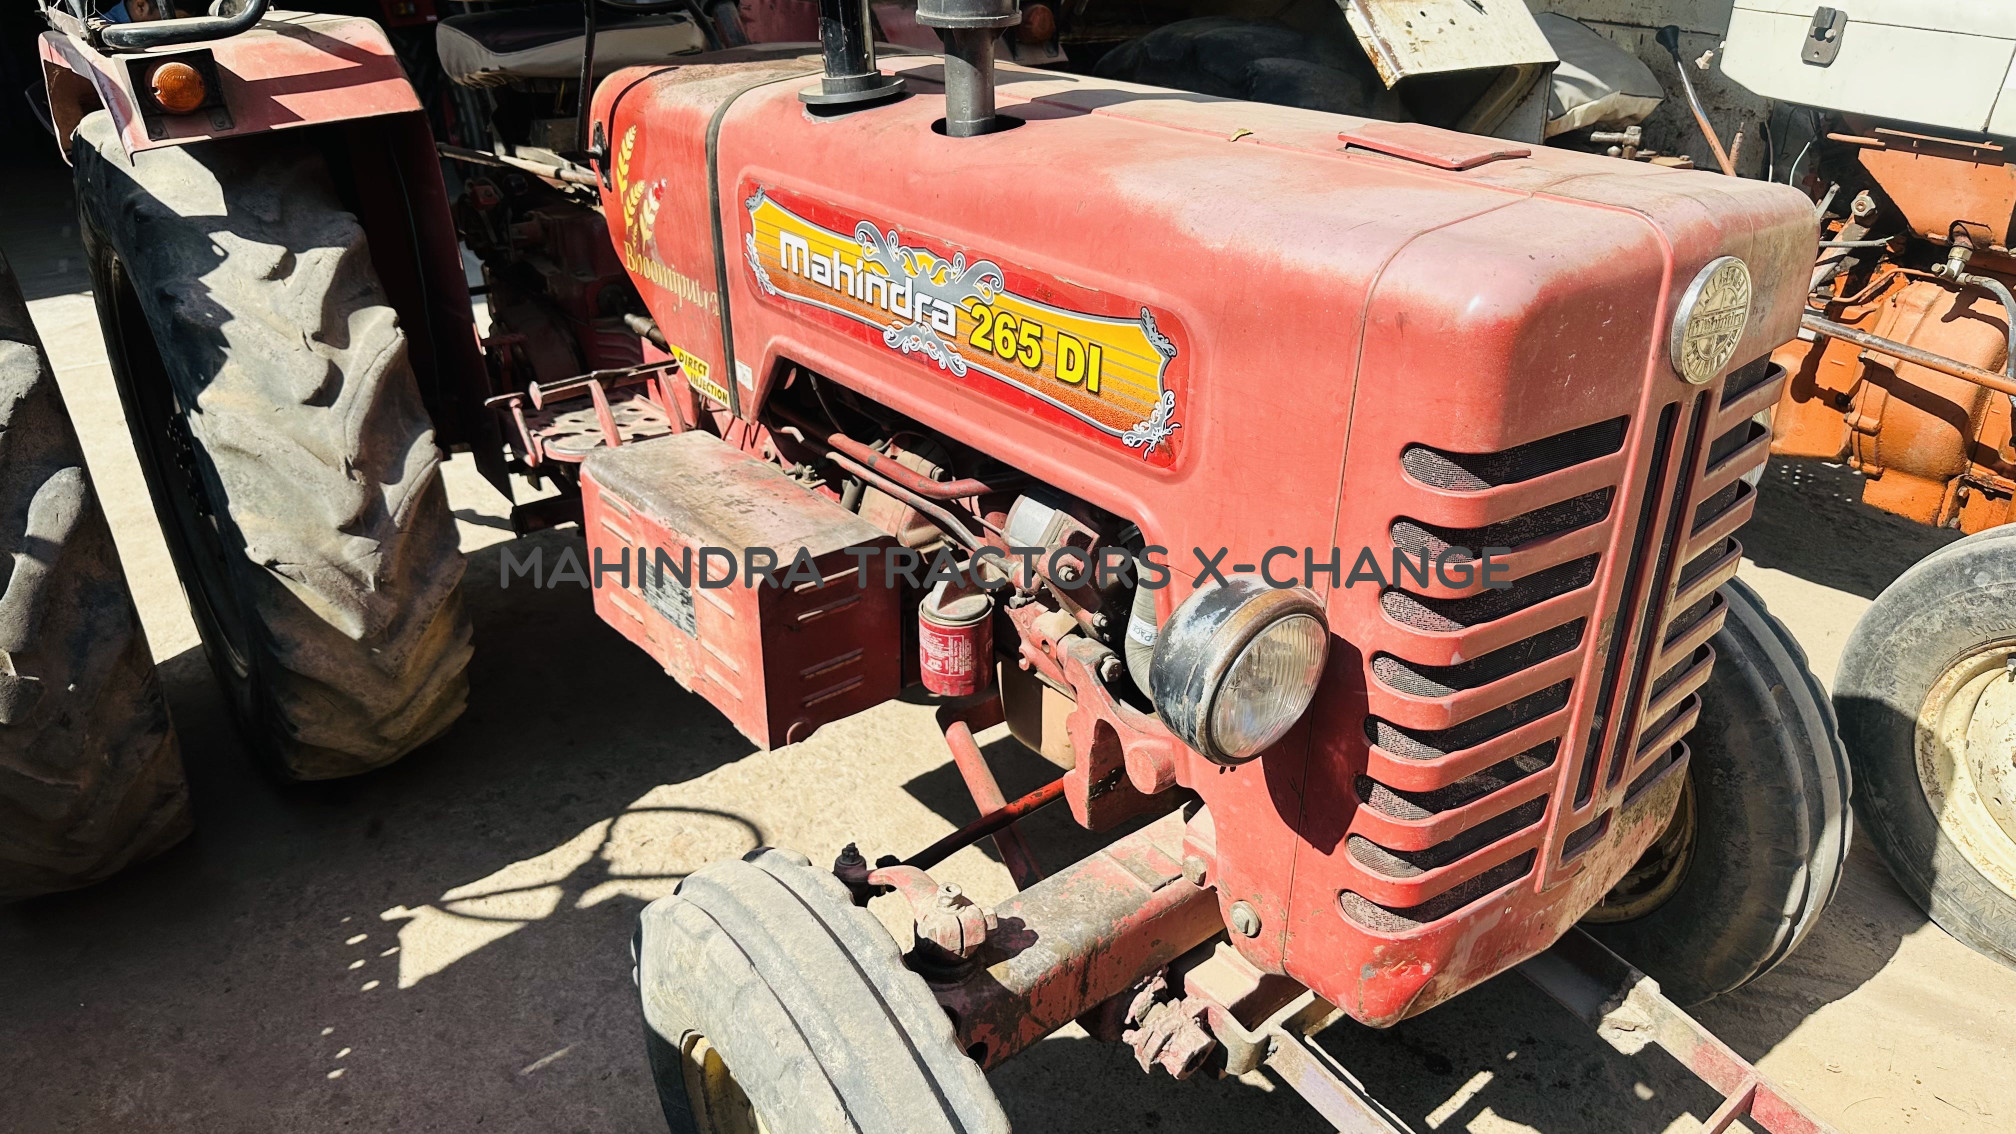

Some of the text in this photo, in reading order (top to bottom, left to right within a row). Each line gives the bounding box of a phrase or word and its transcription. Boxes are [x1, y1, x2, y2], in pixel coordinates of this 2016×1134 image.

[779, 230, 1102, 393] Mahindra 265 DI
[678, 351, 708, 376] DIRECT
[690, 373, 728, 405] INJECTION
